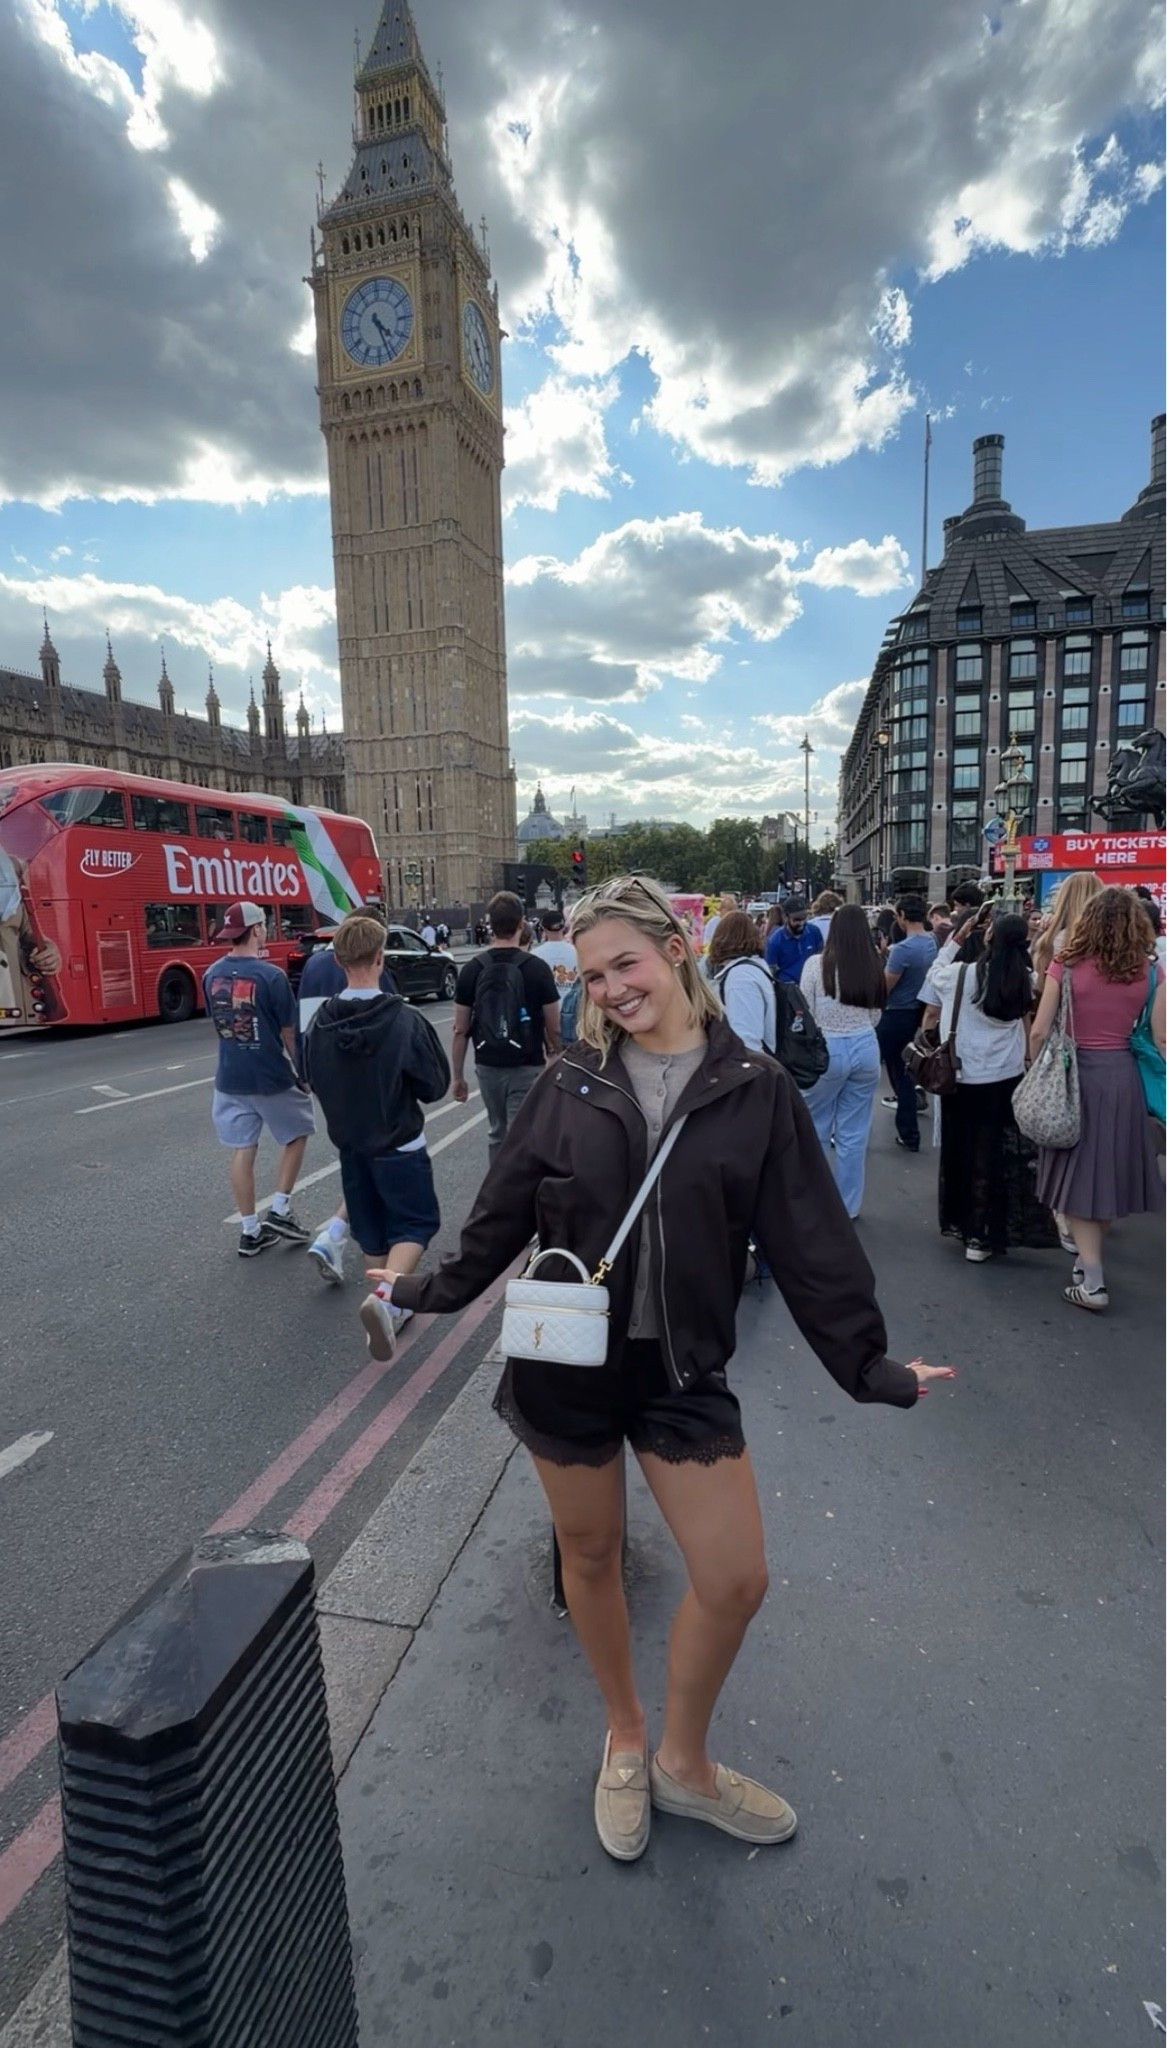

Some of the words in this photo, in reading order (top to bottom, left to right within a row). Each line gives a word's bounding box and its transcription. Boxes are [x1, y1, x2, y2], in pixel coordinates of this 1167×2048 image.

[1066, 838, 1099, 851] BUY
[1102, 836, 1166, 849] TICKETS
[85, 849, 100, 866] FLY
[102, 850, 132, 868] BETTER
[1095, 852, 1137, 864] HERE
[162, 844, 300, 896] Emirates
